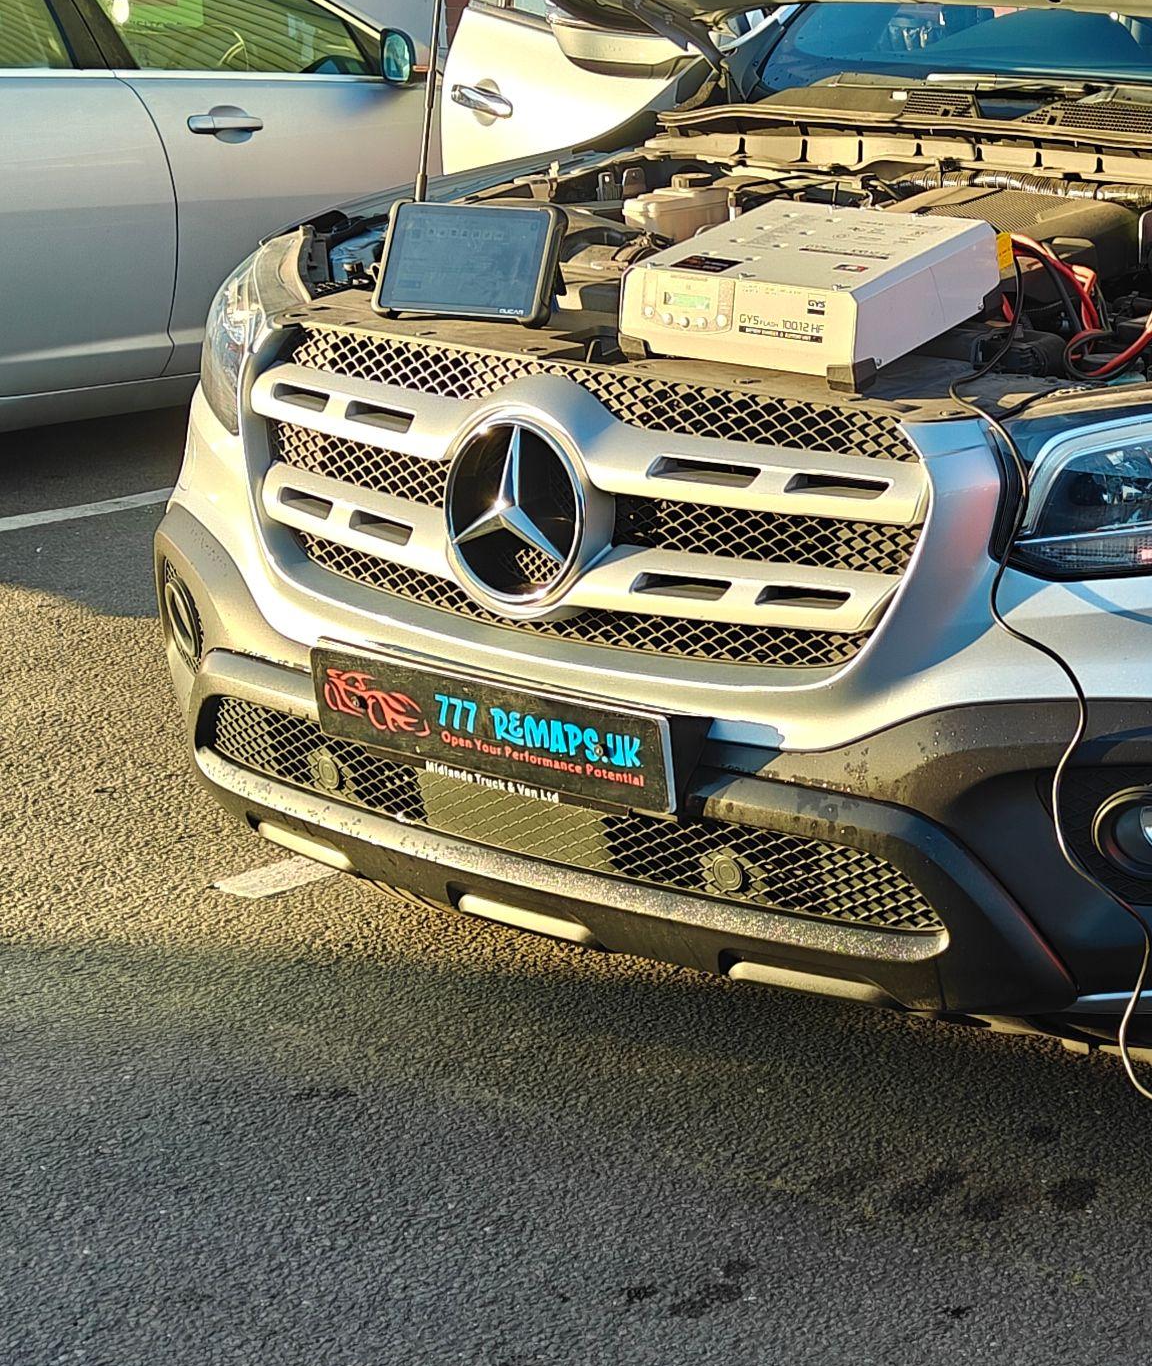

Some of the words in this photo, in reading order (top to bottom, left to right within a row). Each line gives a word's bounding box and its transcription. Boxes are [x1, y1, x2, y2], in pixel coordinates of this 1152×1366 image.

[808, 299, 826, 308] GYS
[435, 693, 477, 734] 777
[441, 730, 472, 749] Open
[474, 739, 502, 756] Your
[504, 745, 583, 775] Performance
[586, 763, 645, 787] Potential
[425, 760, 473, 783] Midlands
[474, 773, 506, 791] Truck
[507, 781, 516, 793] &
[516, 784, 538, 799] Van
[540, 789, 560, 804] Ltd
